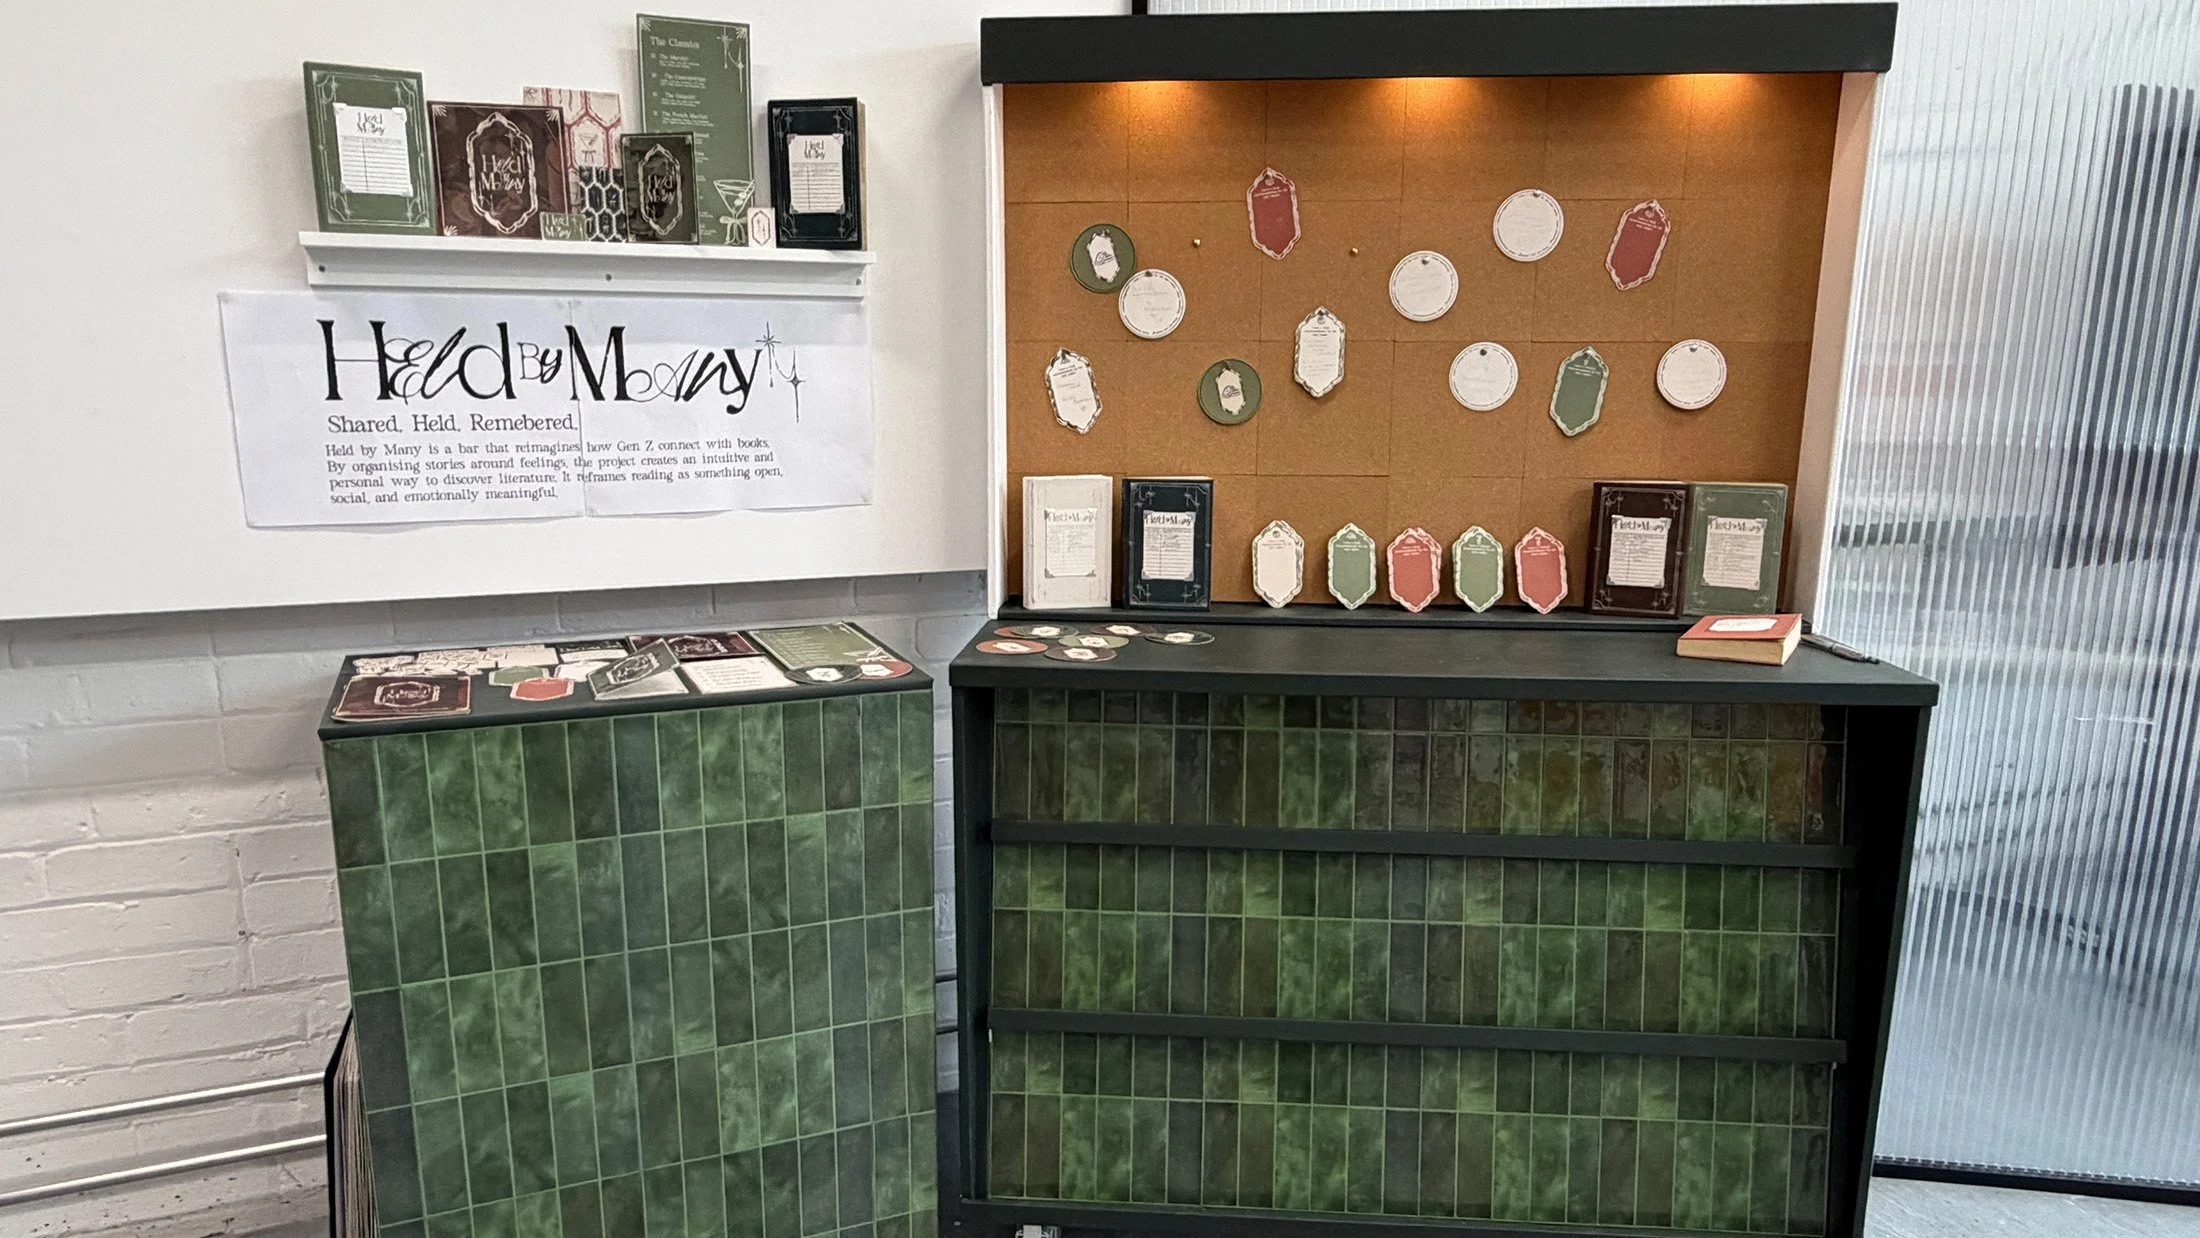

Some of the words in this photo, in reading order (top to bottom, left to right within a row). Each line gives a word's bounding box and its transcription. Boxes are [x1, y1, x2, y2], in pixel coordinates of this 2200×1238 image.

[649, 35, 666, 47] The
[327, 414, 403, 433] Shared.
[411, 414, 461, 432] Held.
[470, 413, 578, 431] Remebered.
[325, 444, 355, 457] Held
[360, 444, 378, 459] by
[383, 443, 422, 457] Many
[428, 442, 440, 454] is
[444, 444, 452, 454] a
[458, 442, 480, 454] bar
[485, 442, 510, 454] that
[515, 440, 581, 456] reimagines
[586, 441, 612, 453] how
[616, 440, 640, 452] Gen
[645, 439, 654, 451] Z
[658, 439, 701, 451] connect
[706, 438, 732, 449] with
[327, 460, 346, 475] By
[352, 459, 421, 475] organising
[425, 457, 466, 471] stories
[470, 456, 515, 469] around
[573, 455, 593, 468] the
[598, 456, 637, 470] project
[640, 454, 678, 466] creates
[682, 454, 697, 465] an
[702, 451, 750, 464] intuitive
[754, 451, 774, 463] and
[329, 476, 385, 491] personal
[391, 476, 419, 489] way
[425, 474, 439, 486] to
[443, 473, 493, 486] discover
[562, 470, 574, 483] It
[576, 470, 627, 483] reframes
[631, 469, 674, 484] reading
[677, 469, 690, 480] as
[694, 466, 751, 480] something
[330, 491, 371, 505] social,
[374, 491, 399, 503] and
[404, 488, 480, 503] emotionally
